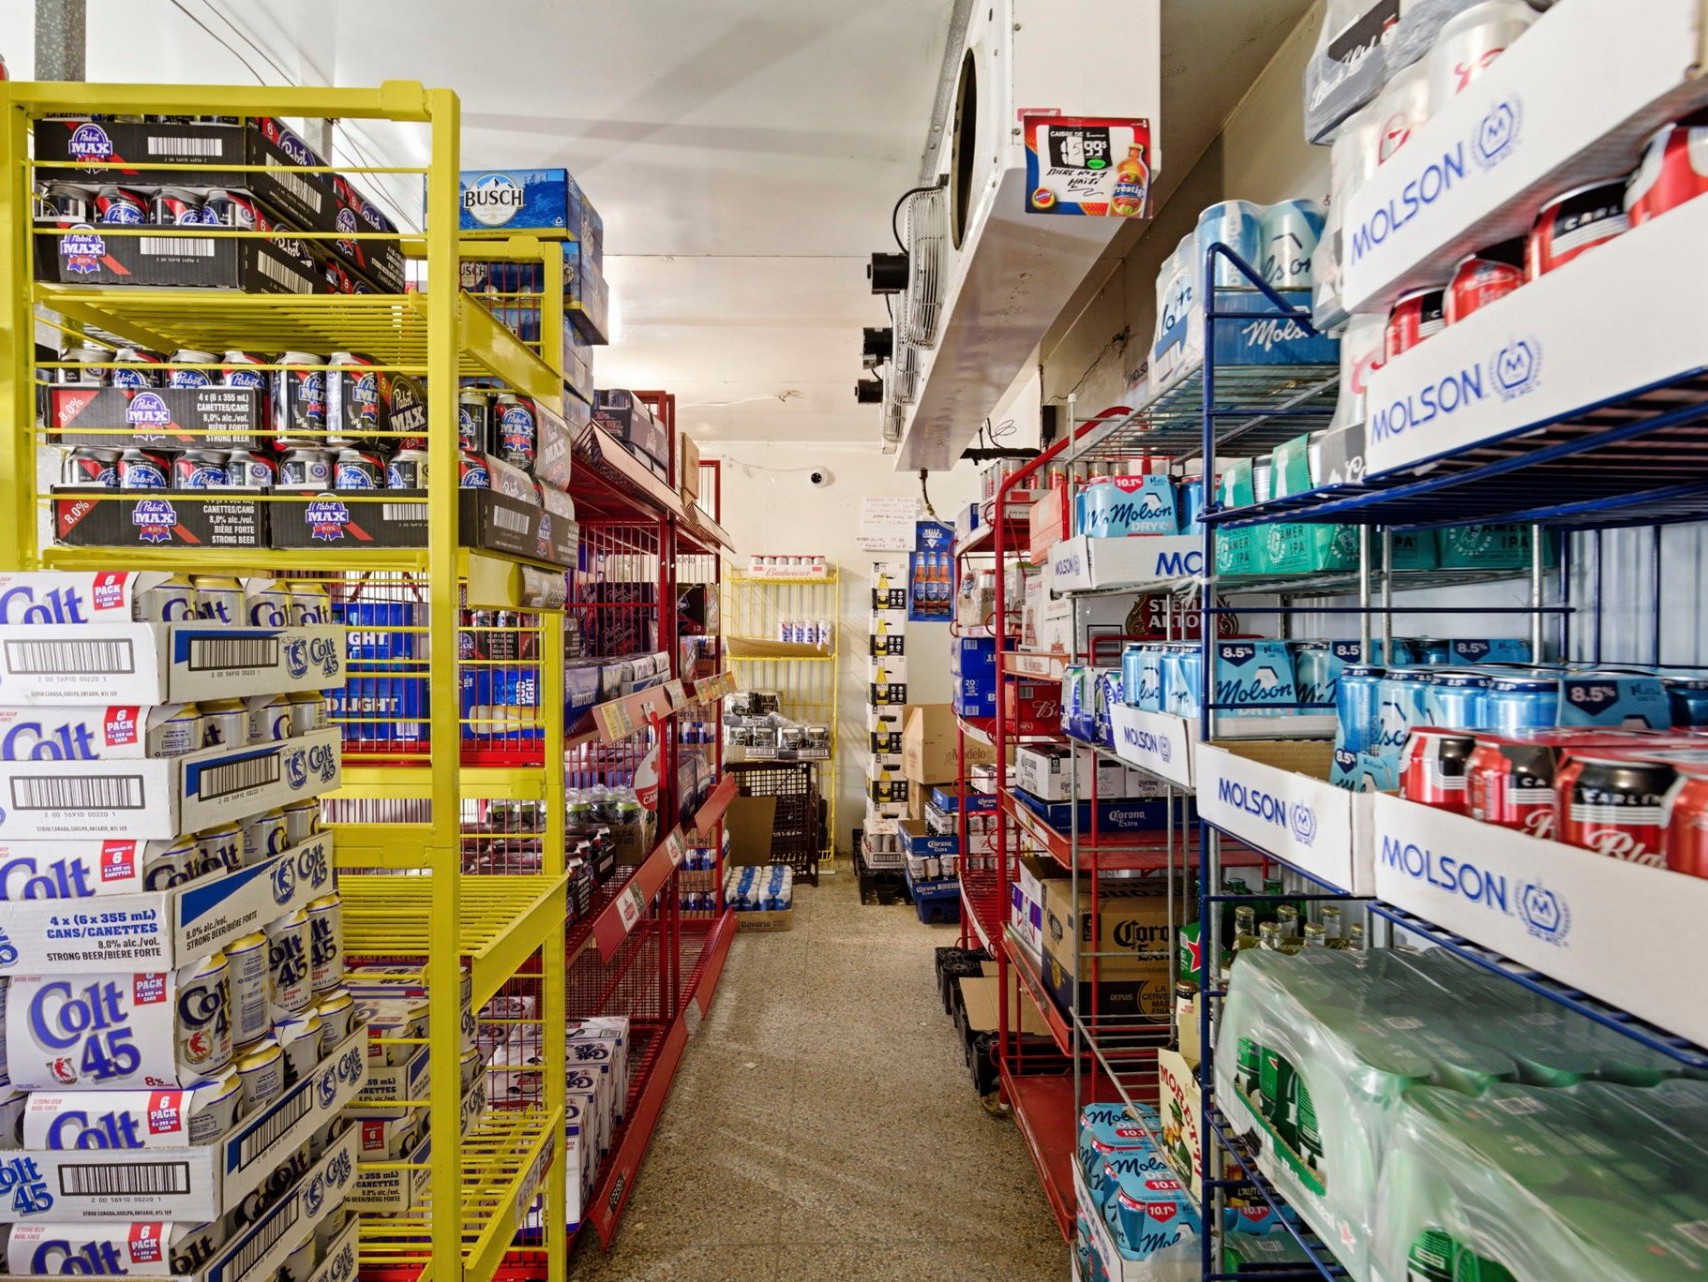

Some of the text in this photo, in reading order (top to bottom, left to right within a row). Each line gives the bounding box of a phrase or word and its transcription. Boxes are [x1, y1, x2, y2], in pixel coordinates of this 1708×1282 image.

[267, 123, 274, 136] 6
[70, 142, 111, 156] MAX
[464, 190, 523, 208] BUSCH
[1351, 143, 1465, 266] MOLSON
[1565, 205, 1620, 230] CARL
[62, 242, 105, 256] MAX
[197, 404, 250, 412] CANETTES/CANS
[1371, 362, 1483, 446] MOLSON
[129, 411, 168, 424] MAX
[500, 422, 534, 436] MAX
[136, 512, 174, 525] MAX
[309, 510, 347, 523] MAX
[1110, 502, 1172, 529] Molson
[238, 536, 254, 544] BEER
[766, 567, 811, 577] Budweiser
[105, 575, 116, 586] 6
[95, 584, 121, 596] PACK
[310, 636, 335, 664] Colt
[1222, 647, 1253, 658] 8.5%
[1337, 644, 1361, 656] 8.5
[1458, 642, 1488, 653] 8.5%
[322, 655, 339, 675] 45
[1216, 678, 1292, 712] Molson
[1570, 686, 1616, 702] 8.5%
[117, 710, 127, 720] 6
[107, 720, 134, 732] PACK
[2, 722, 100, 760] Colt
[1124, 726, 1158, 754] MOLSON
[309, 744, 334, 774] Colt
[1336, 750, 1357, 764] 8.5%
[321, 760, 336, 782] 45
[1218, 777, 1288, 829] MOLSON
[1109, 810, 1146, 821] Corona
[1119, 820, 1138, 828] Extra
[112, 852, 123, 864] 6
[298, 842, 326, 880] Colt
[0, 857, 98, 900] Colt
[308, 866, 328, 891] 45
[1382, 834, 1508, 913] MOLSON
[50, 916, 57, 926] 4
[74, 914, 88, 926] (6
[90, 916, 98, 924] x
[100, 912, 127, 924] 355
[130, 909, 156, 922] mL)
[47, 922, 158, 939] CANS/CANETTES
[186, 916, 228, 940] 8.0% alc./vol.
[187, 934, 210, 951] STRONG
[242, 910, 258, 926] FORTE
[98, 936, 160, 950] 8.0% alc./vol.
[47, 948, 162, 962] STRONG BEER/BIÈRE FORTE
[136, 978, 163, 990] PACK
[26, 980, 129, 1051] Colt
[80, 1026, 142, 1082] 45
[338, 1044, 360, 1081] Colt
[160, 1096, 170, 1109] 6
[150, 1109, 177, 1120] PACK
[46, 1110, 146, 1150] Colt
[326, 1148, 350, 1188] Colt
[12, 1182, 54, 1217] 45
[1149, 1206, 1174, 1216] 10.1%
[140, 1225, 151, 1238] 6
[131, 1240, 158, 1250] PACK
[30, 1239, 128, 1276] Colt
